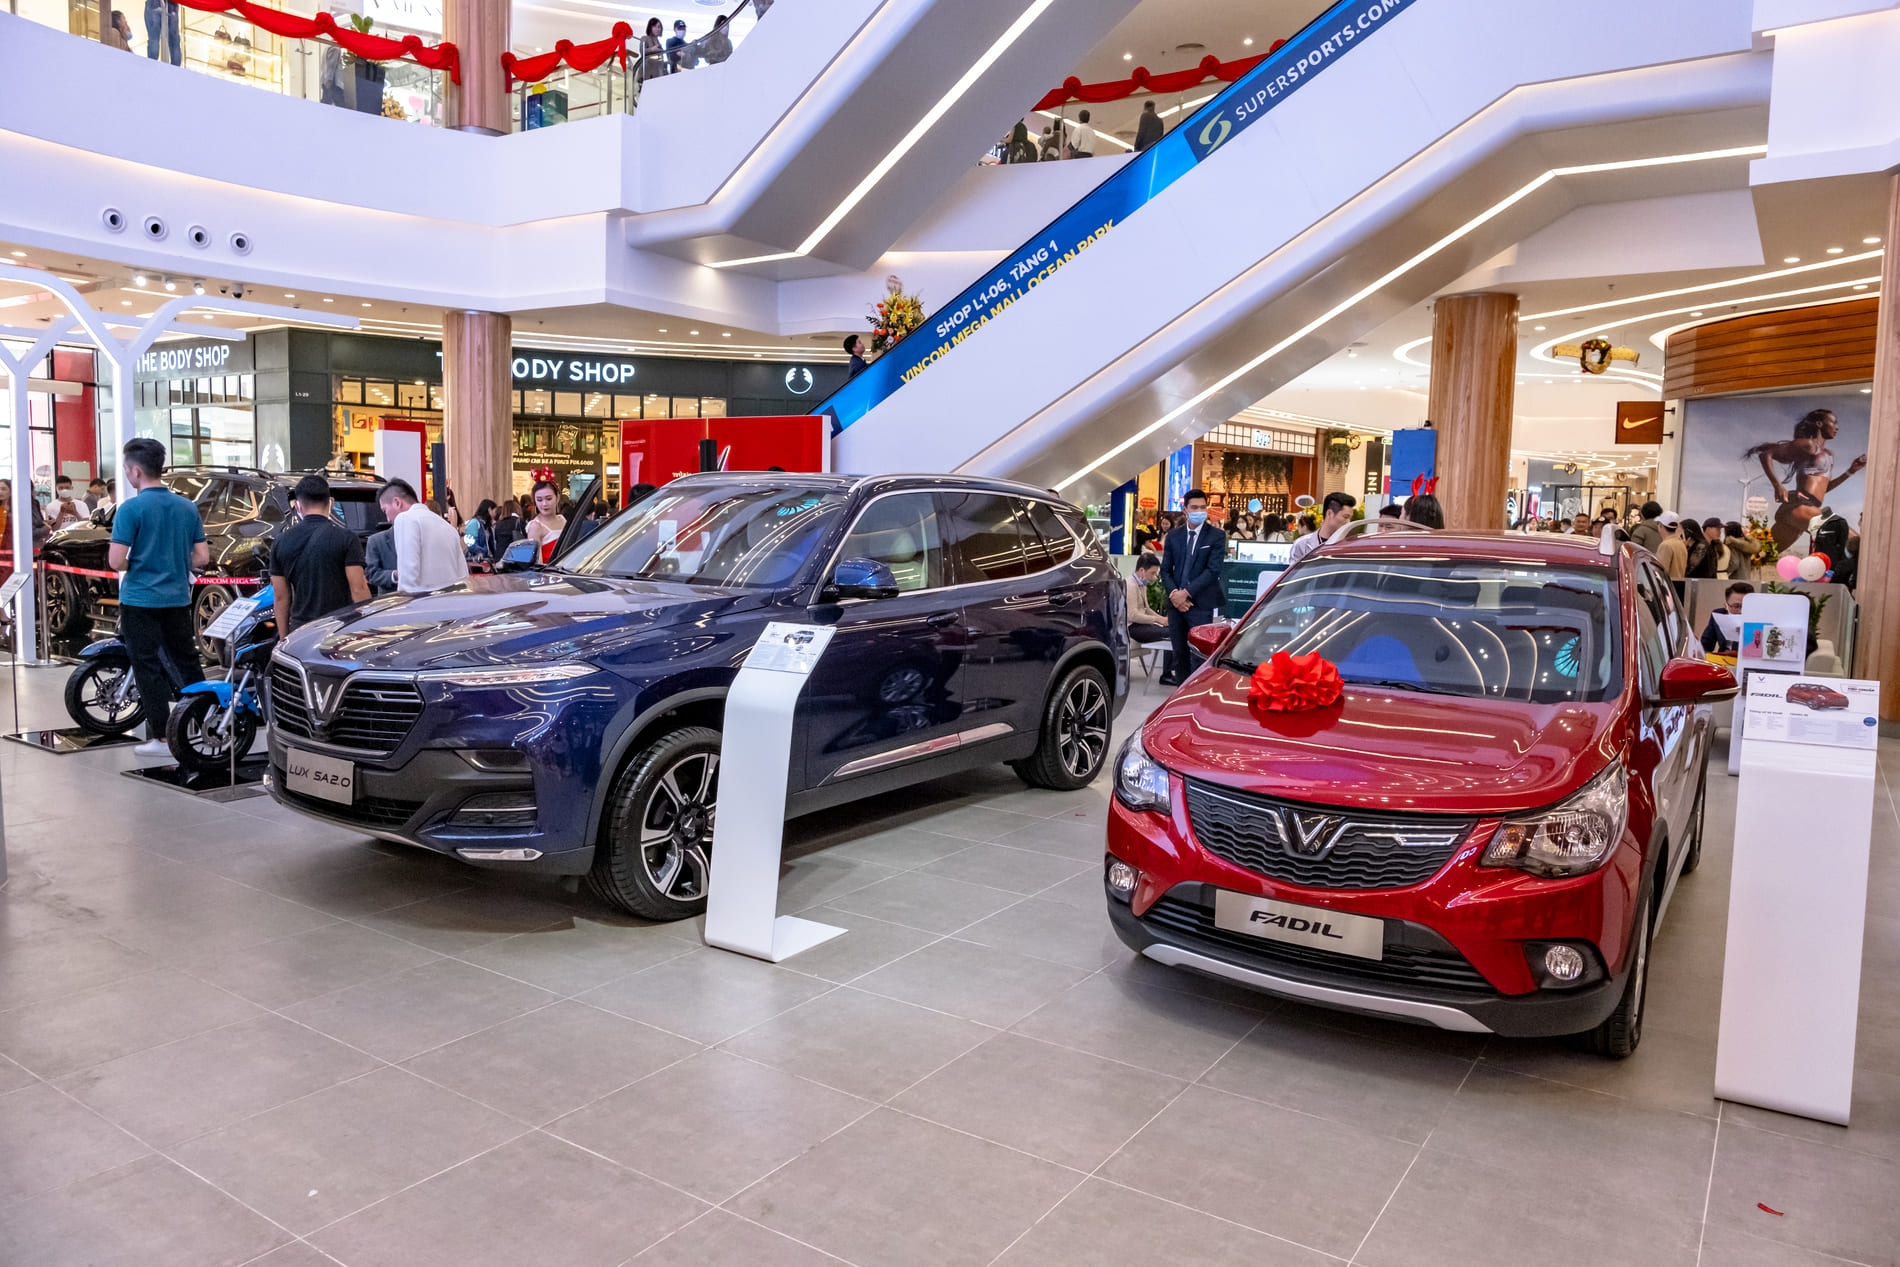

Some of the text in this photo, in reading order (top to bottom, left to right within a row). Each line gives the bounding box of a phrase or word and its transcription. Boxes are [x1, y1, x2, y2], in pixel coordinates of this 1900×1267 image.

[936, 304, 972, 338] SHOP
[975, 278, 1012, 312] L1-06,
[1049, 239, 1059, 252] 1
[900, 341, 951, 384] VINCOM
[951, 314, 990, 349] MEGA
[1027, 249, 1077, 292] OCEAN
[160, 348, 193, 371] BODY
[195, 344, 230, 368] SHOP
[510, 357, 636, 384] ODY SHOP
[1367, 471, 1378, 495] INI
[199, 577, 229, 585] VINCOM
[229, 577, 249, 585] MEGA
[289, 763, 351, 788] LUX SA2.0
[1249, 910, 1343, 940] FADIL
